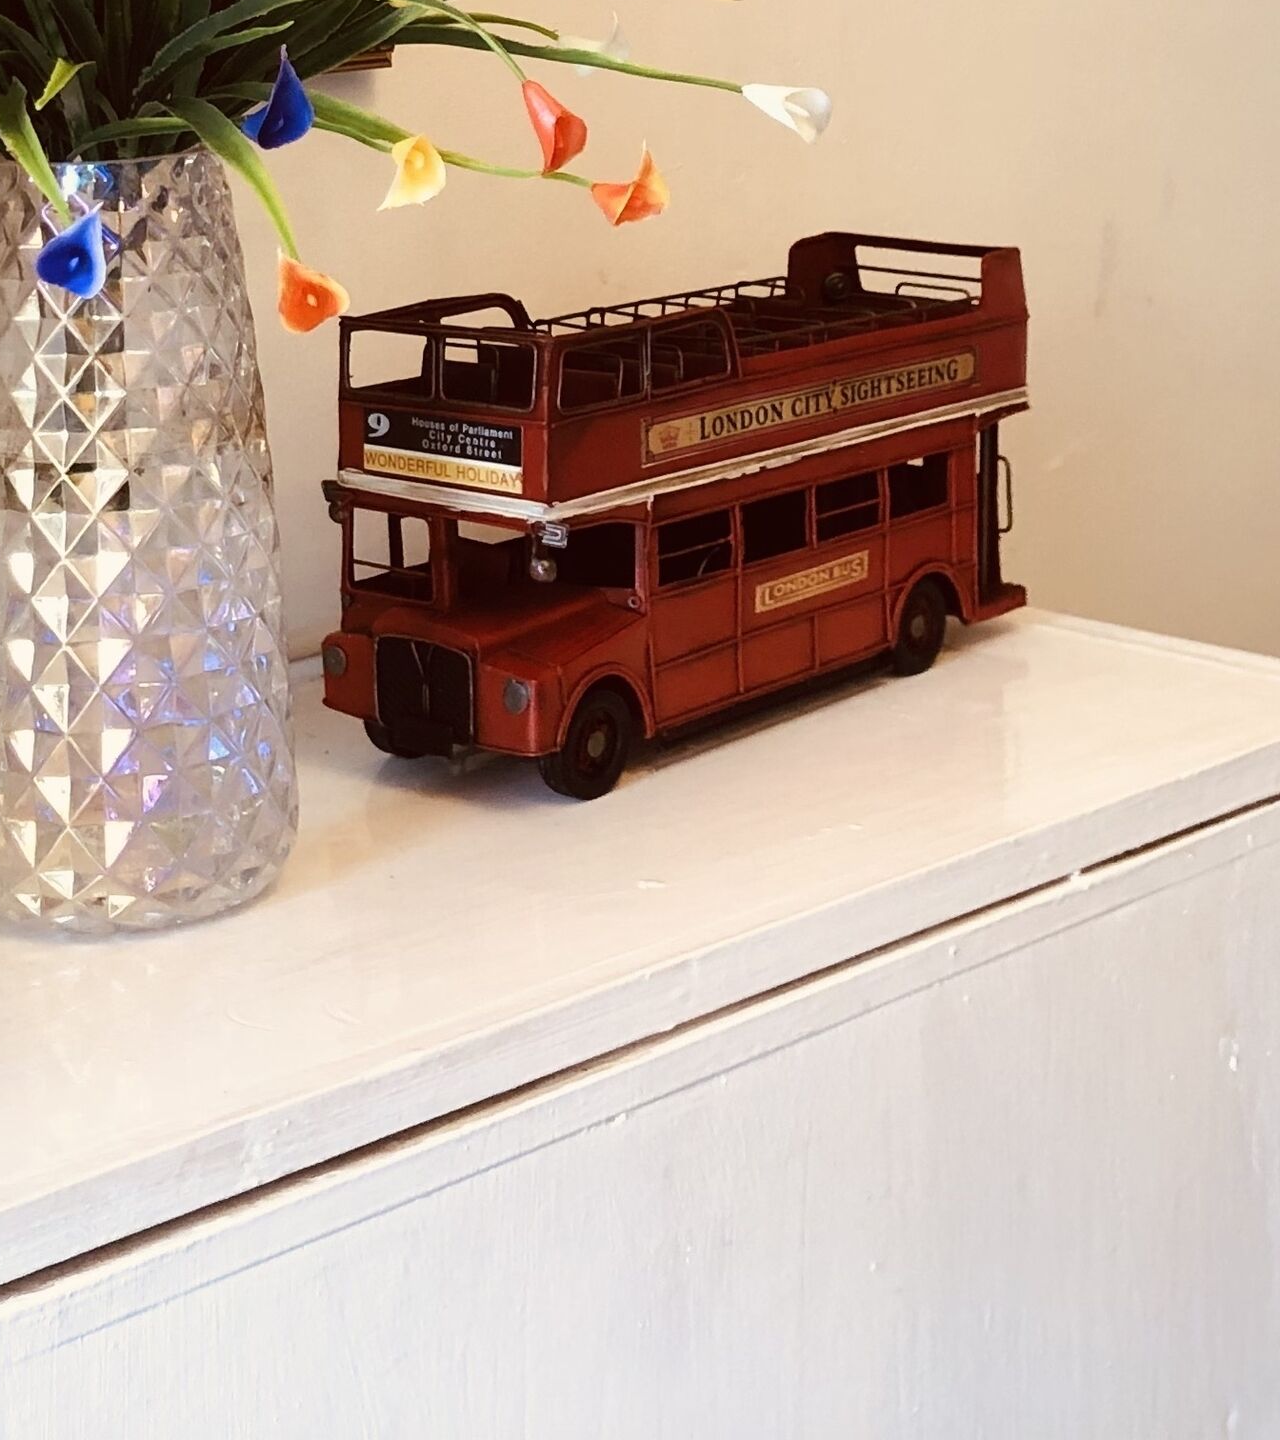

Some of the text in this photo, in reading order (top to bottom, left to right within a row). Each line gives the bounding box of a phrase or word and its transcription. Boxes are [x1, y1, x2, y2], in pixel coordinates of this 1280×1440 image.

[699, 359, 959, 441] LONDON CITY SIGHTSEEING
[367, 412, 391, 438] 9
[411, 416, 514, 440] Houses of Parliament
[422, 438, 503, 460] Oxford Street
[428, 430, 497, 449] City Centre
[365, 451, 453, 478] WONDERFUL
[764, 559, 862, 605] LONDON BUS
